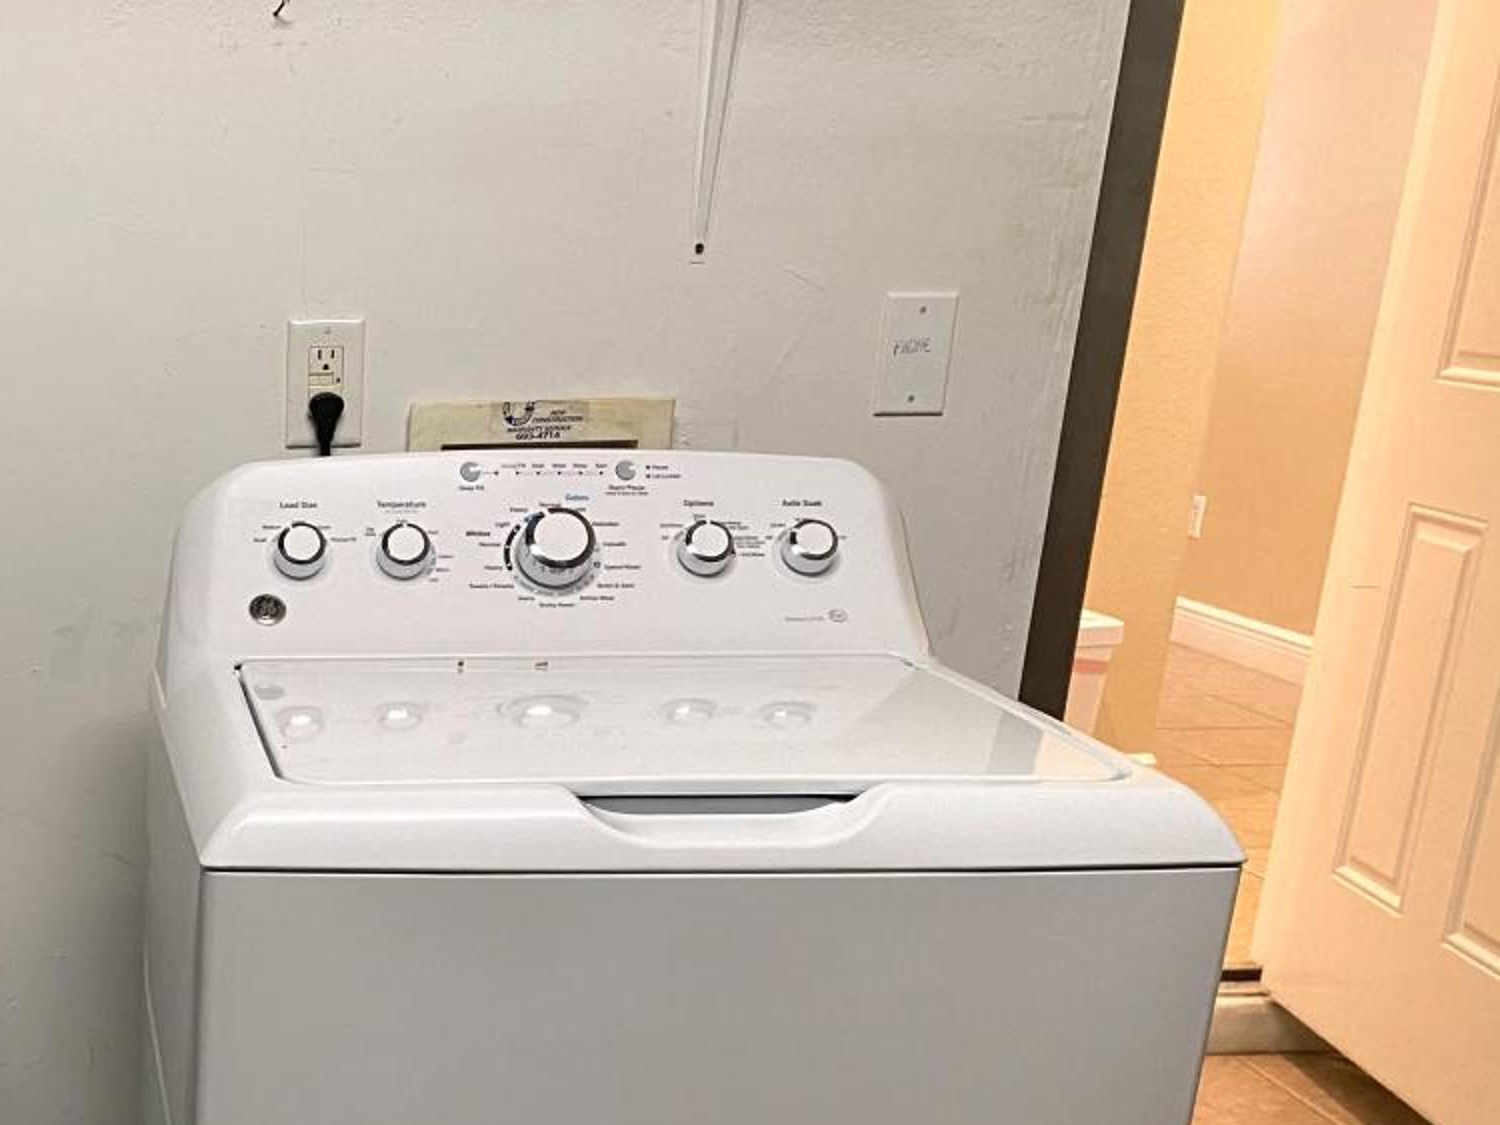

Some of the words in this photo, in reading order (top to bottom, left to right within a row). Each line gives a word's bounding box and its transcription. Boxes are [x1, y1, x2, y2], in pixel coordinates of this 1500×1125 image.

[279, 501, 299, 509] Load
[377, 500, 428, 510] Temperature
[781, 499, 801, 507] Auto
